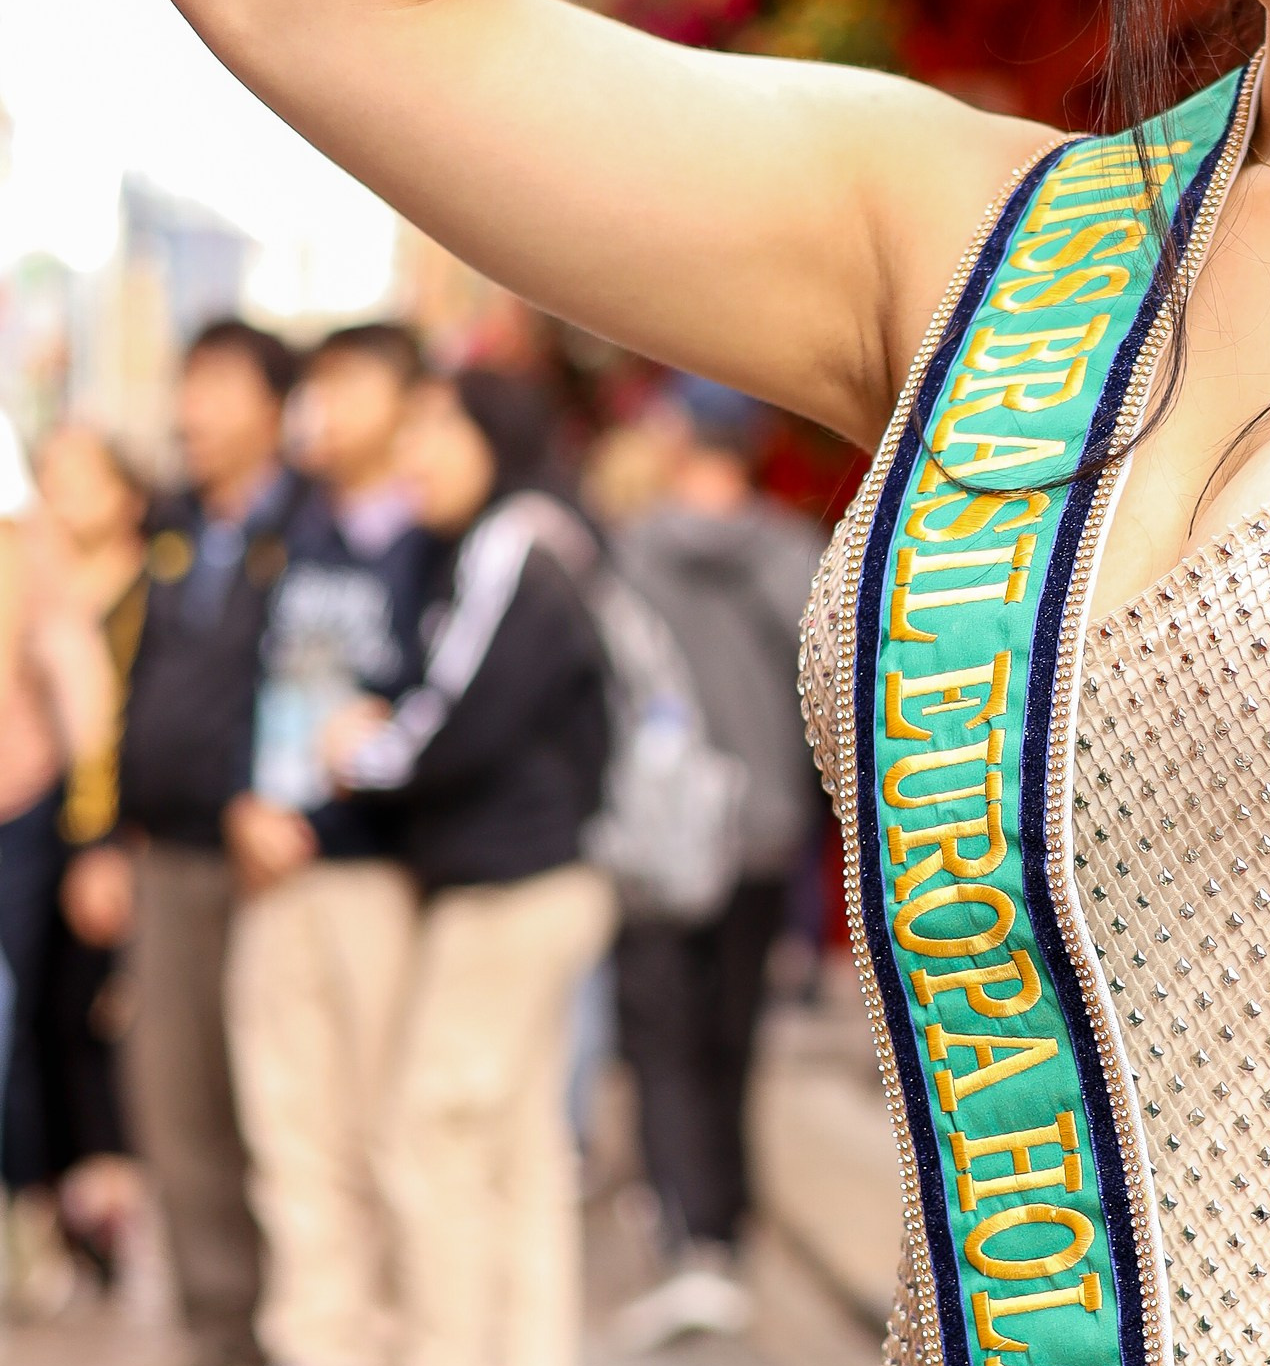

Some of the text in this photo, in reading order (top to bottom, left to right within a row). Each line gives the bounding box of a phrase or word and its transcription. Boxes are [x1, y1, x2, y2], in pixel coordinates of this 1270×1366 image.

[990, 139, 1193, 315] MISS
[888, 313, 1112, 644] BRASIL
[882, 649, 1060, 1113] EUROPA
